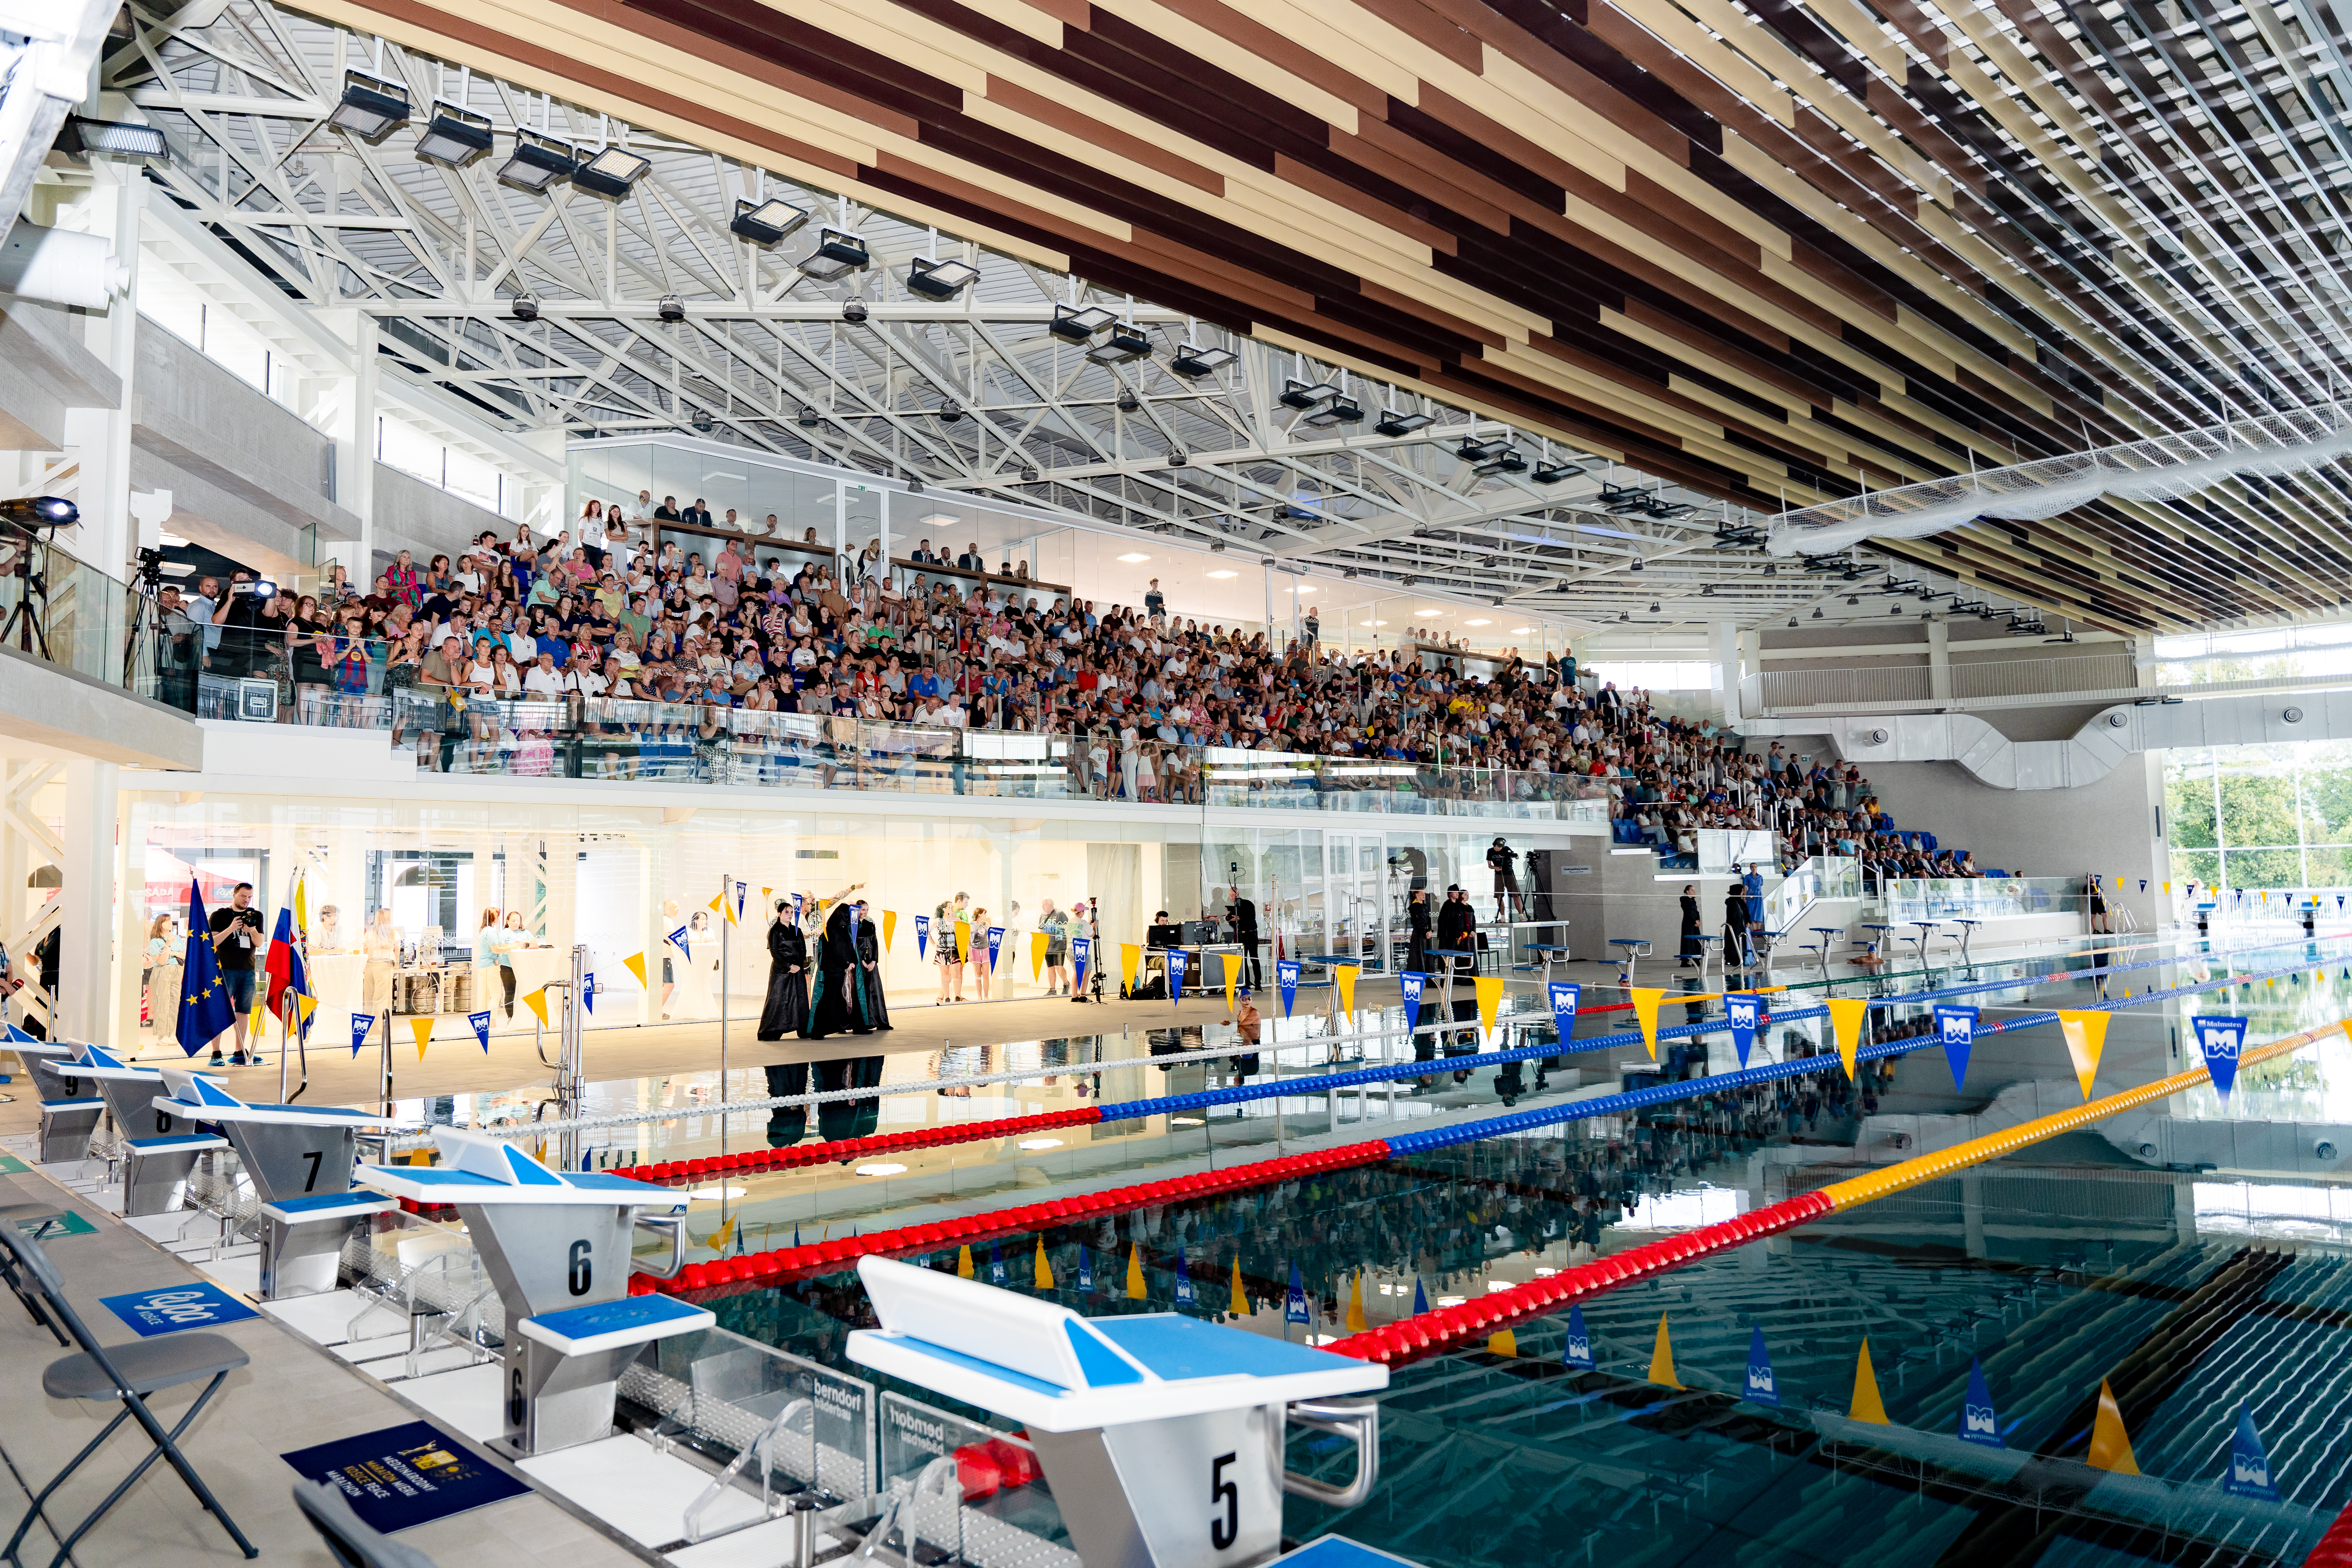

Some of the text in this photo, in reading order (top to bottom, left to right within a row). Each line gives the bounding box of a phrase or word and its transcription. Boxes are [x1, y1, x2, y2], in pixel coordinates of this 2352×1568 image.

[65, 1076, 78, 1096] 9
[156, 1109, 172, 1133] 8
[303, 1151, 322, 1192] 7
[569, 1239, 591, 1296] 6
[138, 1311, 163, 1326] KOŠICE
[512, 1367, 522, 1426] 6
[814, 1377, 861, 1412] berndorf
[814, 1395, 851, 1422] bäderbau
[325, 1470, 364, 1497] MARATHON
[343, 1466, 391, 1499] KOŠICE PEACE
[365, 1460, 399, 1482] MARATON
[392, 1481, 419, 1497] MIERU
[1212, 1452, 1238, 1550] 5
